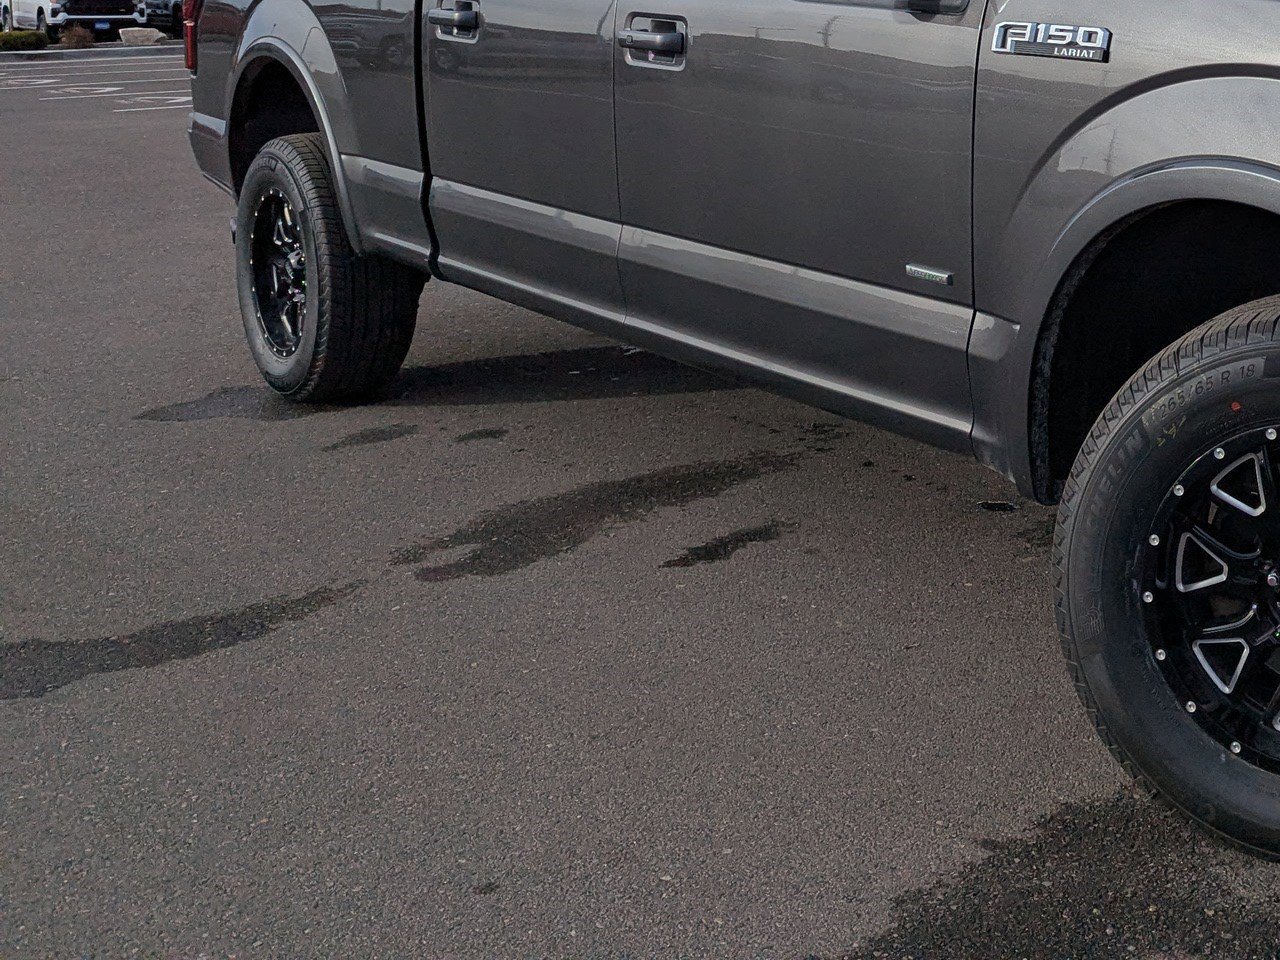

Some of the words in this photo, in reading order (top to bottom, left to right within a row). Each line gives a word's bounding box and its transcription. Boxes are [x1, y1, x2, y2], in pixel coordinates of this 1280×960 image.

[1054, 47, 1096, 58] LARIAT
[1160, 375, 1214, 419] 265/65
[1220, 370, 1231, 384] R
[1240, 363, 1256, 379] 18
